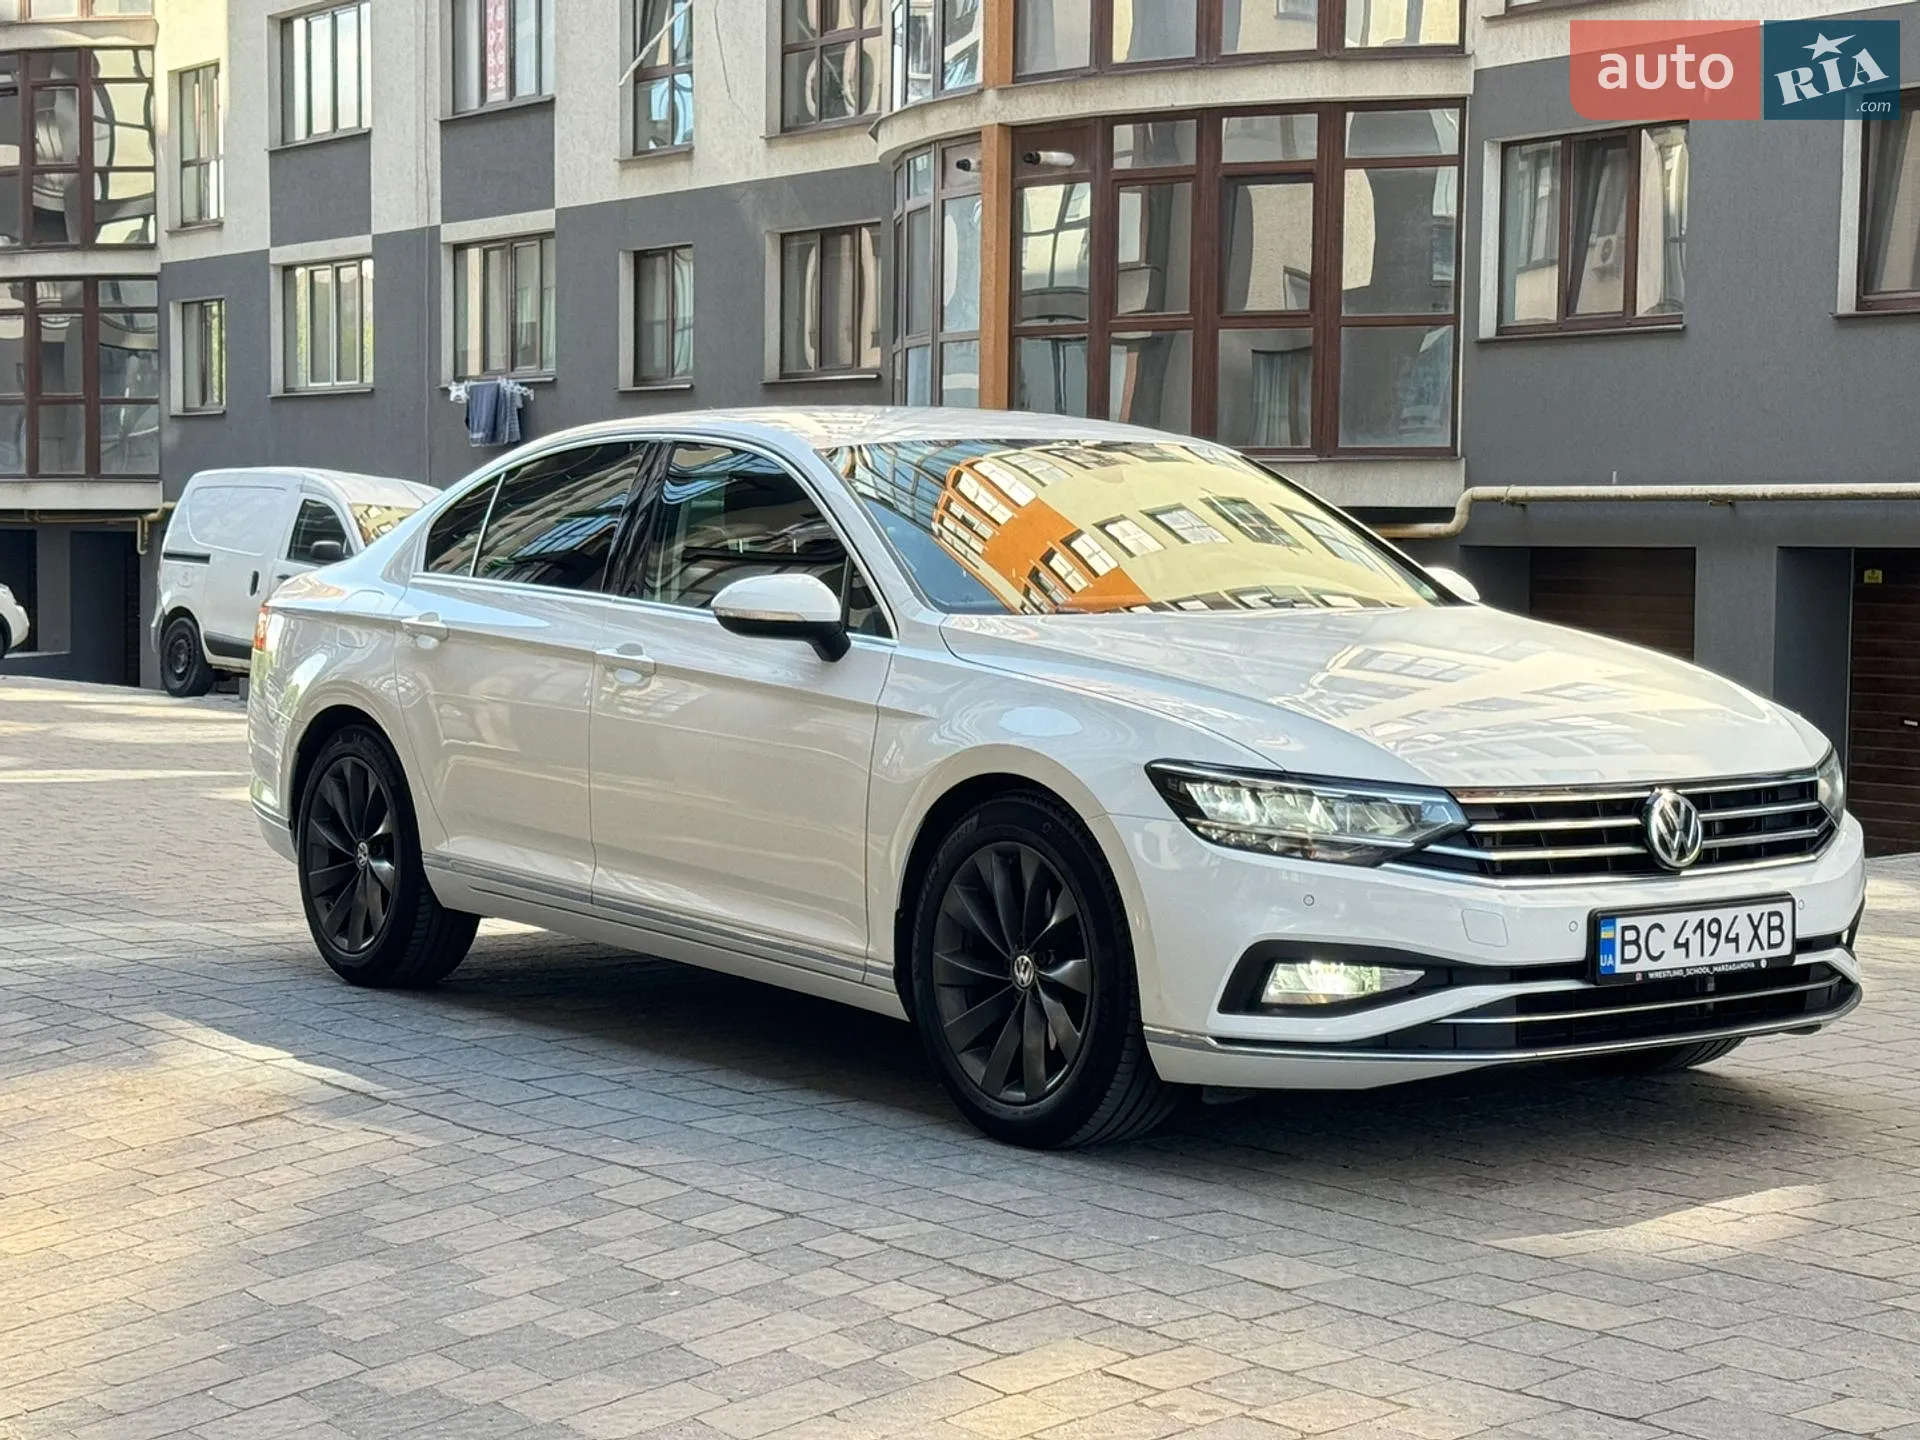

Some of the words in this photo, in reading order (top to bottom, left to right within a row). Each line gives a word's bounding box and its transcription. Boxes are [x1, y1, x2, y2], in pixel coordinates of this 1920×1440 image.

[1620, 922, 1666, 965] BC
[1673, 914, 1741, 960] 4194
[1746, 910, 1786, 953] XB
[1600, 955, 1614, 967] UA
